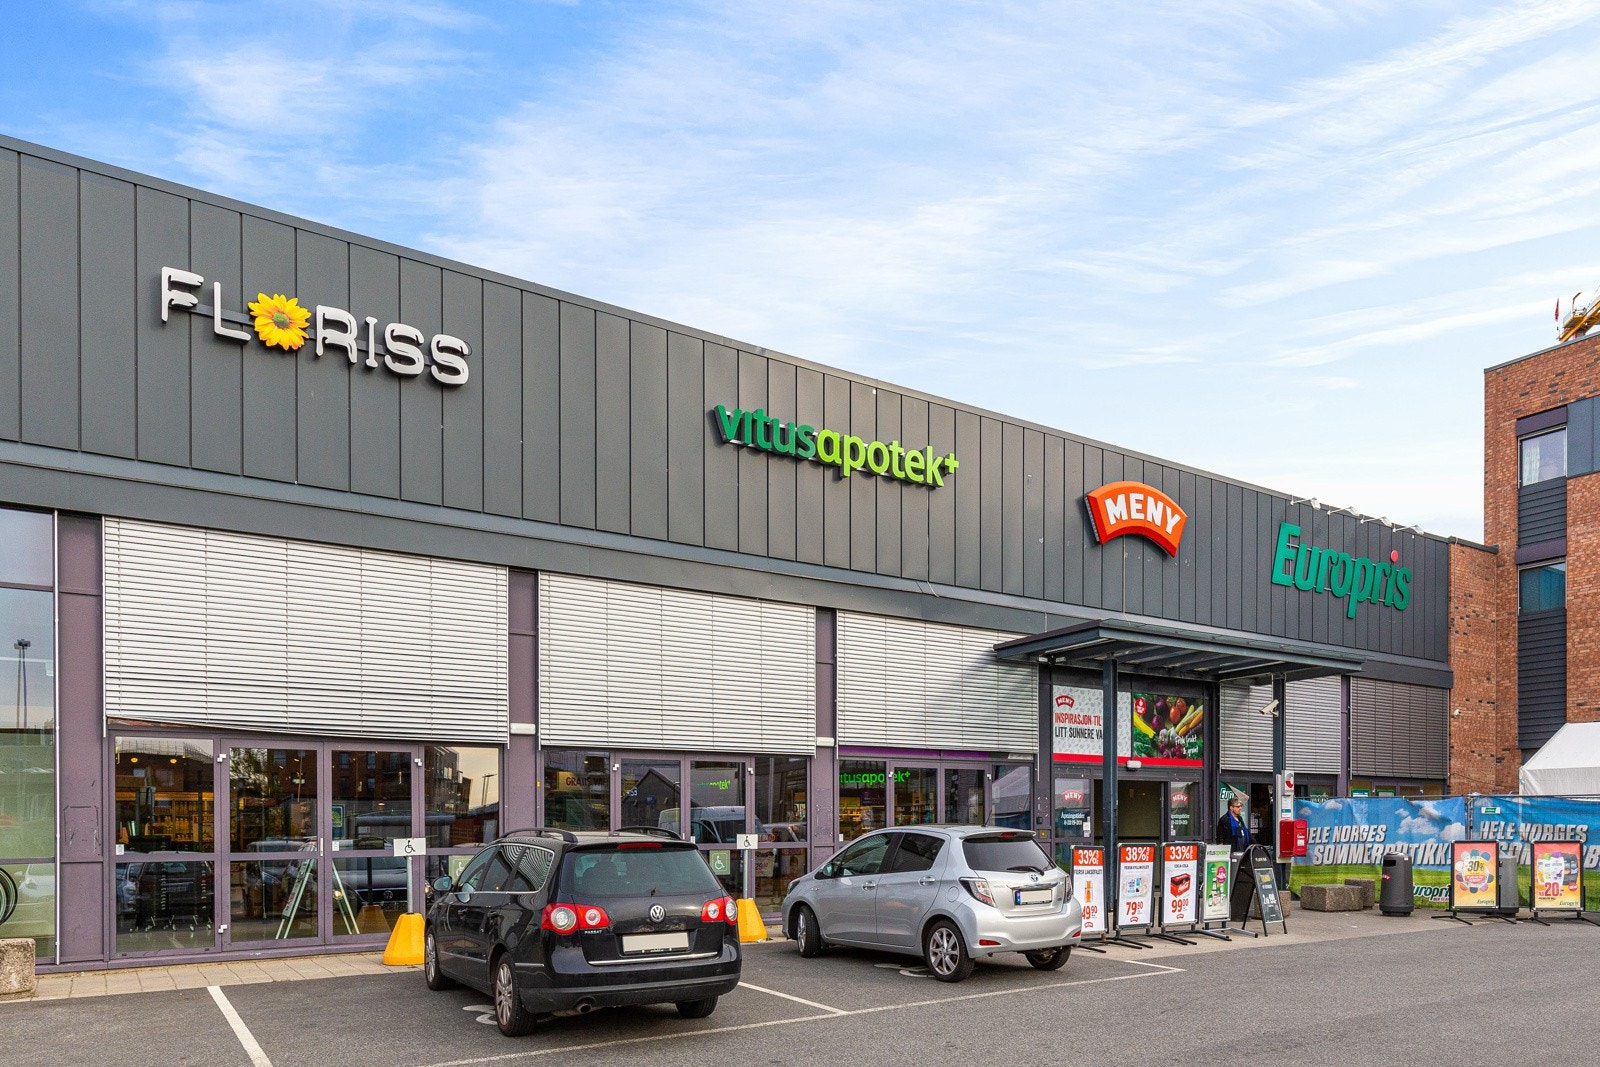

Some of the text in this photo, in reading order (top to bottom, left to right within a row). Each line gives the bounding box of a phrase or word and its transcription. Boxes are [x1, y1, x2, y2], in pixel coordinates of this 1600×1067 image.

[1104, 491, 1181, 535] MENY
[1271, 522, 1412, 619] Europris
[1056, 696, 1074, 707] MENY
[1055, 712, 1103, 727] INSPIRASJON TIL
[1055, 727, 1104, 740] LITT SUNNERE VA
[1333, 824, 1387, 843] NORGES
[1480, 820, 1589, 844] HELE NORGES
[1078, 849, 1096, 865] 33%
[1125, 846, 1146, 861] 38%
[1169, 845, 1189, 860] 33%
[1413, 885, 1450, 900] uropri
